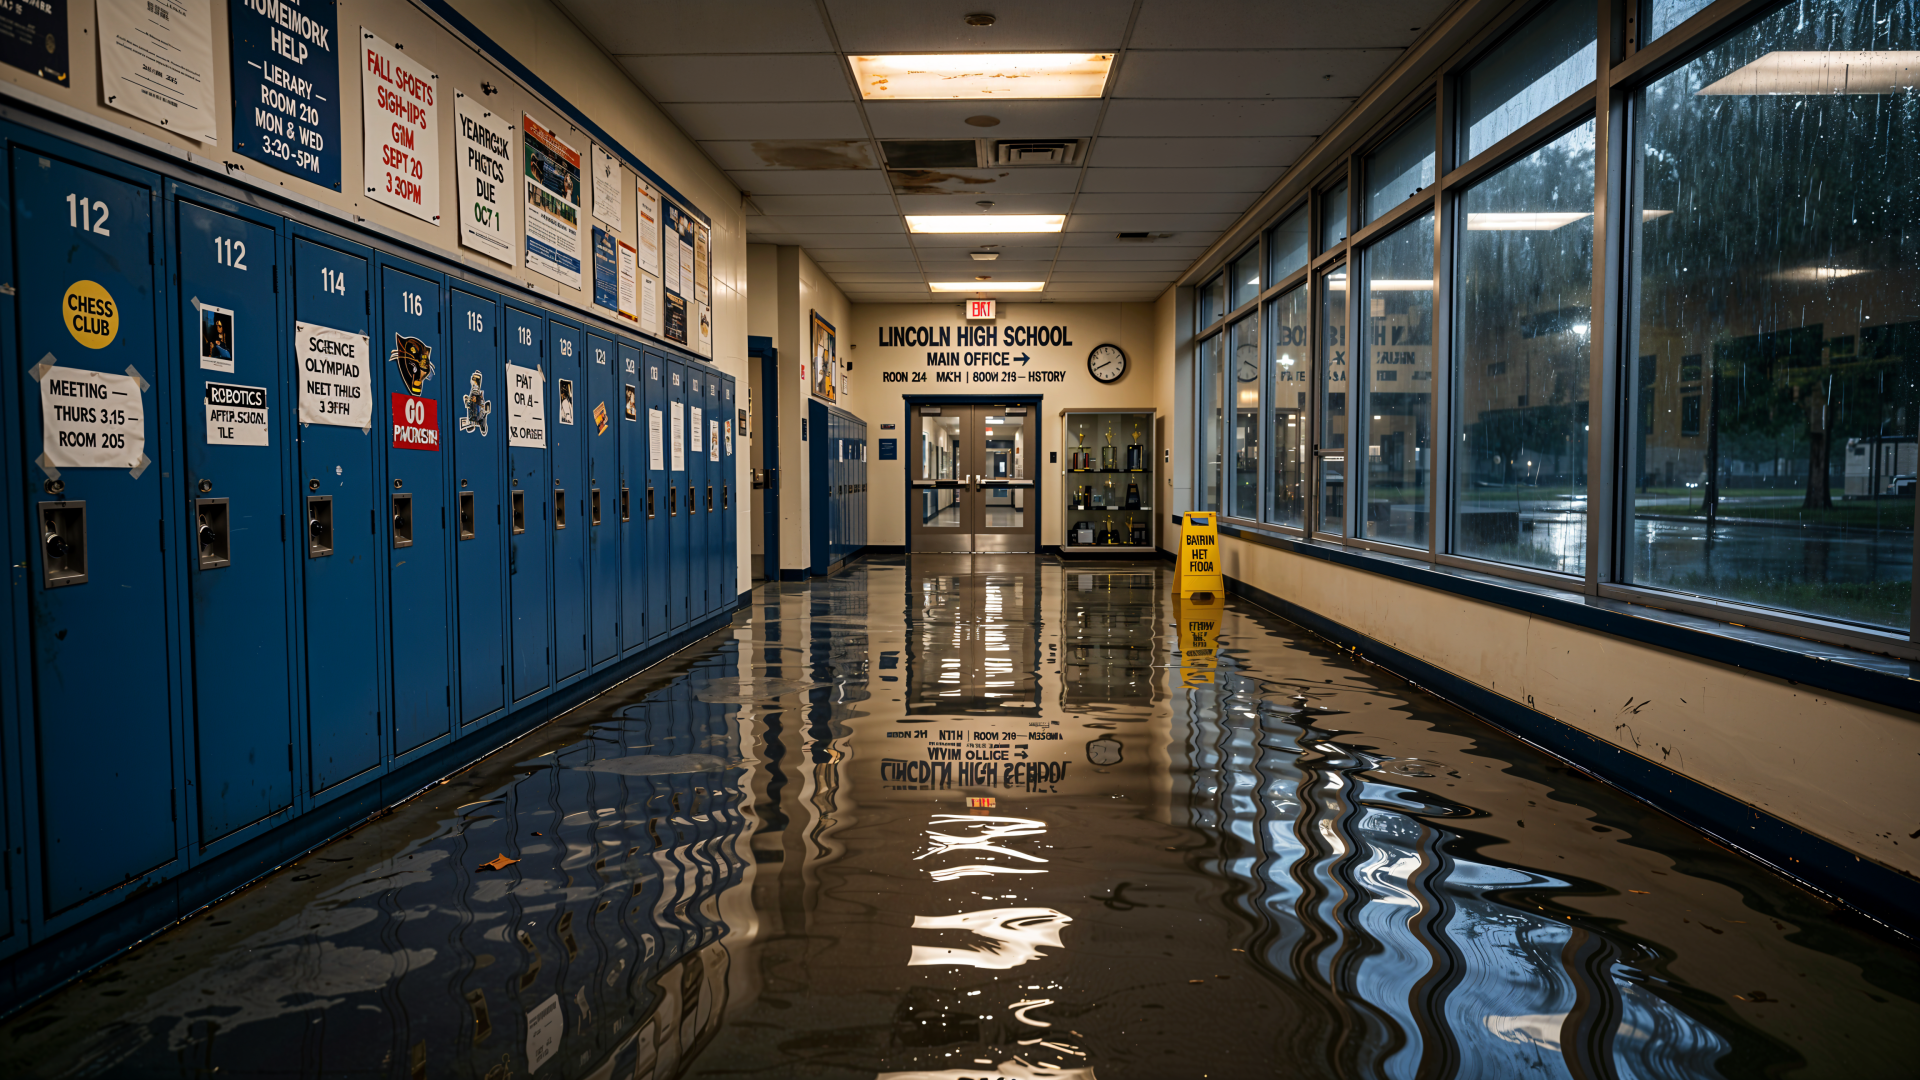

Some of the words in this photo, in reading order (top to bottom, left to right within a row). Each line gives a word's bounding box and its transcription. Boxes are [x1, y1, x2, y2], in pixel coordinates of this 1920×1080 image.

[271, 26, 308, 65] HELP
[367, 48, 393, 84] FALL
[261, 83, 296, 118] ROOM
[299, 103, 319, 126] 210
[255, 106, 283, 136] MON
[286, 121, 296, 141] &
[298, 125, 324, 152] WED
[382, 143, 409, 174] SEPT
[410, 156, 423, 180] 20
[476, 176, 496, 204] DUE
[66, 193, 110, 237] 112
[214, 236, 248, 271] 112
[321, 267, 346, 297] 114
[67, 293, 114, 318] CHESS
[402, 291, 423, 317] 116
[72, 314, 110, 336] CLUB
[467, 310, 483, 333] 116
[517, 326, 532, 347] 118
[879, 326, 951, 347] LINCOLN
[957, 326, 998, 347] HIGH
[1003, 325, 1073, 347] SCHOOL
[305, 357, 360, 378] OLYMPIAD
[927, 352, 960, 366] MAIN
[964, 351, 1010, 366] OFFICE
[1028, 370, 1066, 383] HSTORY
[49, 379, 108, 400] MEETING
[53, 404, 97, 424] THURS
[405, 398, 425, 425] GO
[101, 433, 125, 449] 205
